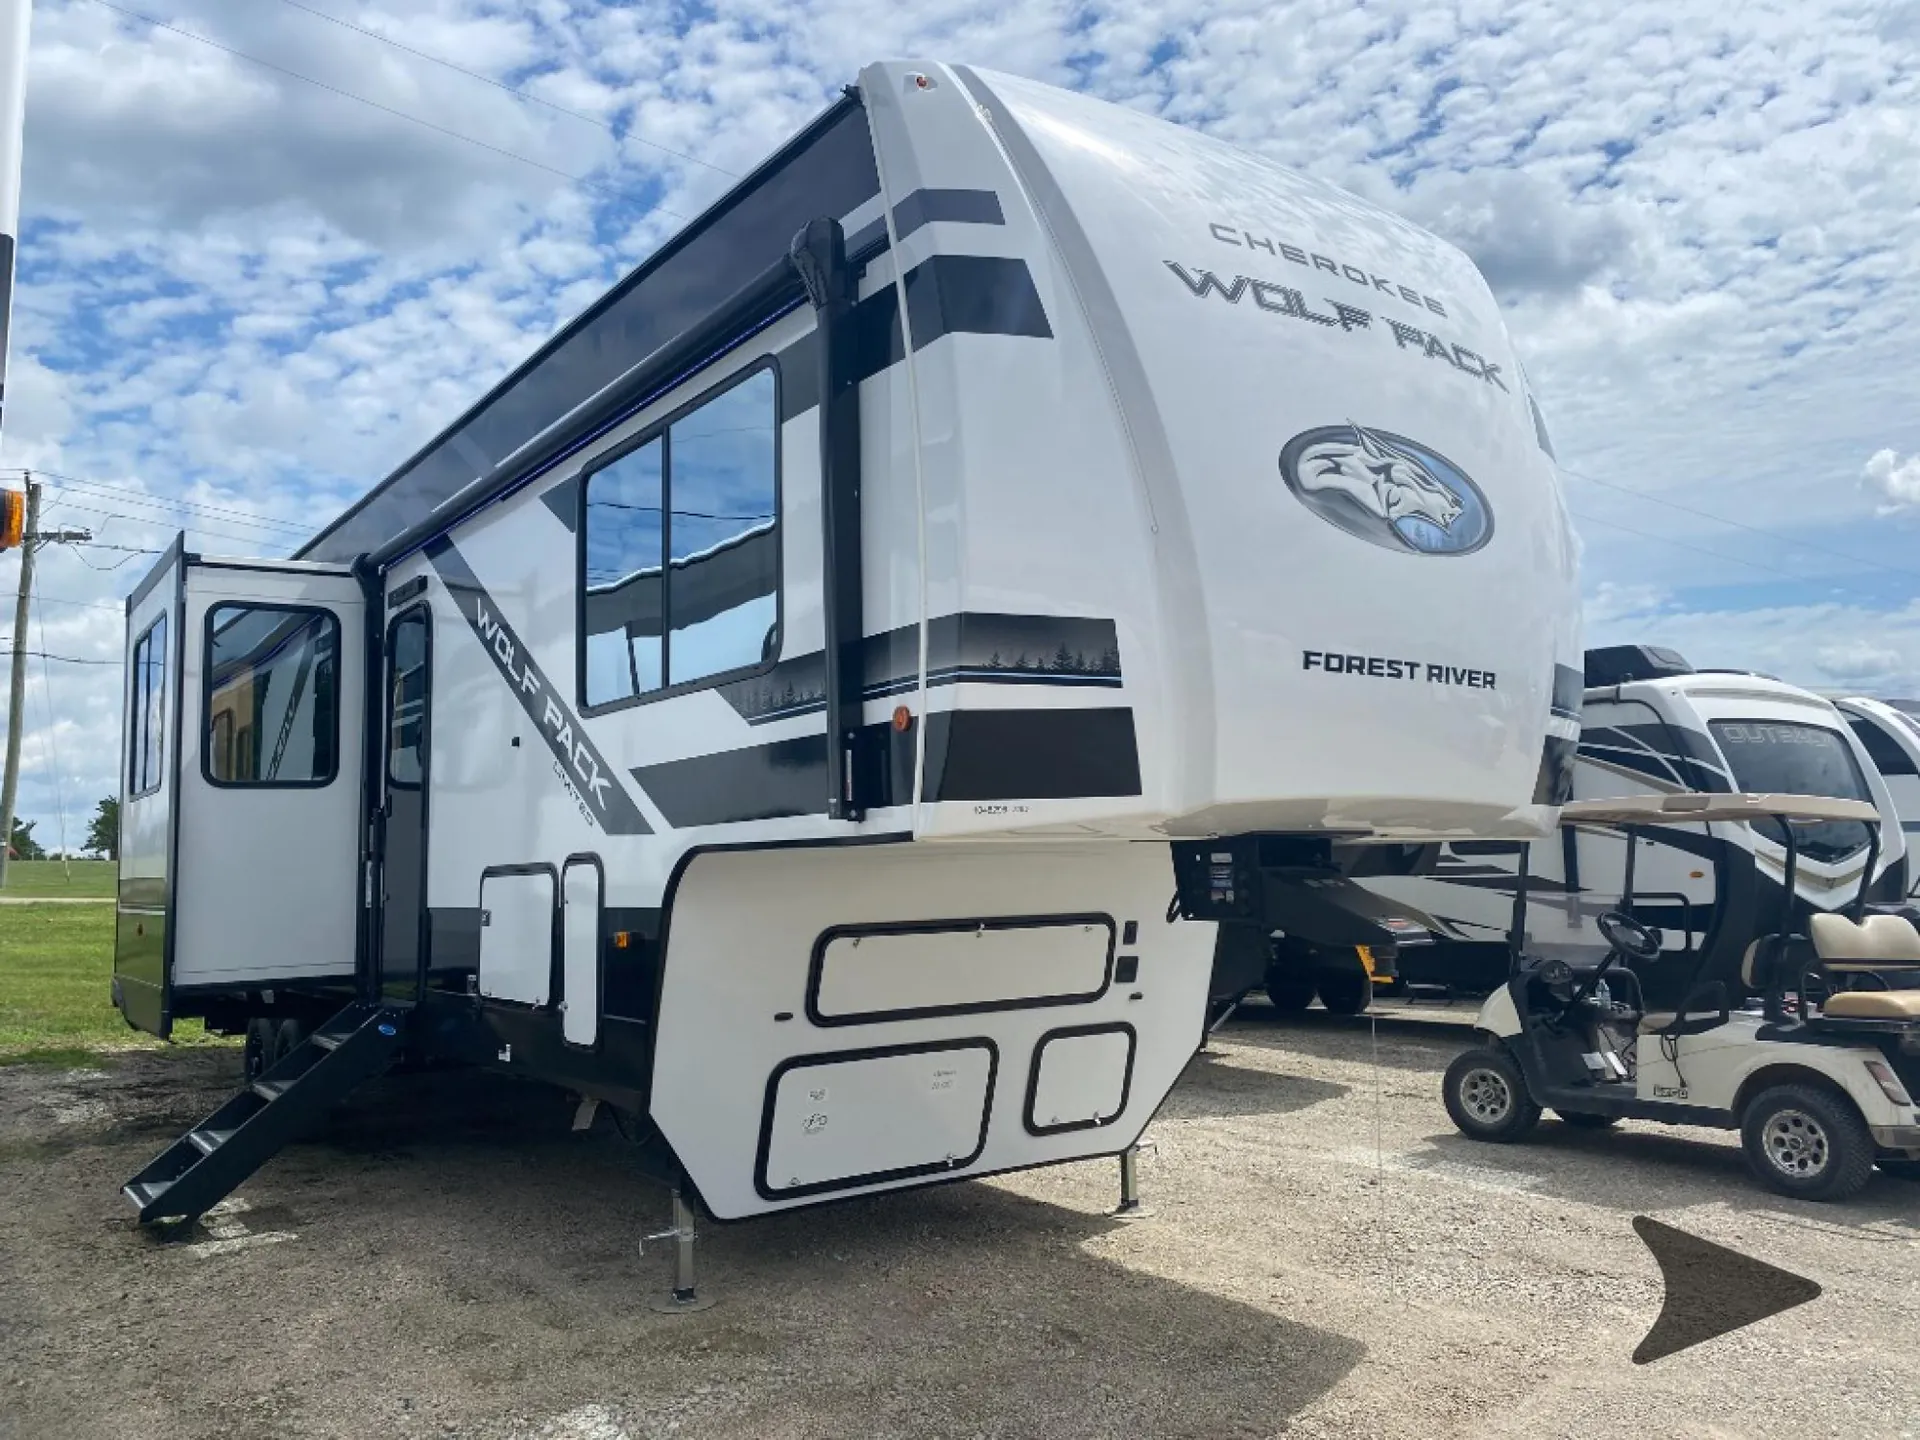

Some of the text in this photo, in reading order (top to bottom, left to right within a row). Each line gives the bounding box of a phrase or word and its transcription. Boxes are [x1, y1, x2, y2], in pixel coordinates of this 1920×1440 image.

[1162, 259, 1511, 394] WOLF PACK
[1208, 222, 1449, 319] CHEROKEE
[477, 597, 613, 811] WOLF PACK
[1302, 650, 1497, 690] FOREST RIVER
